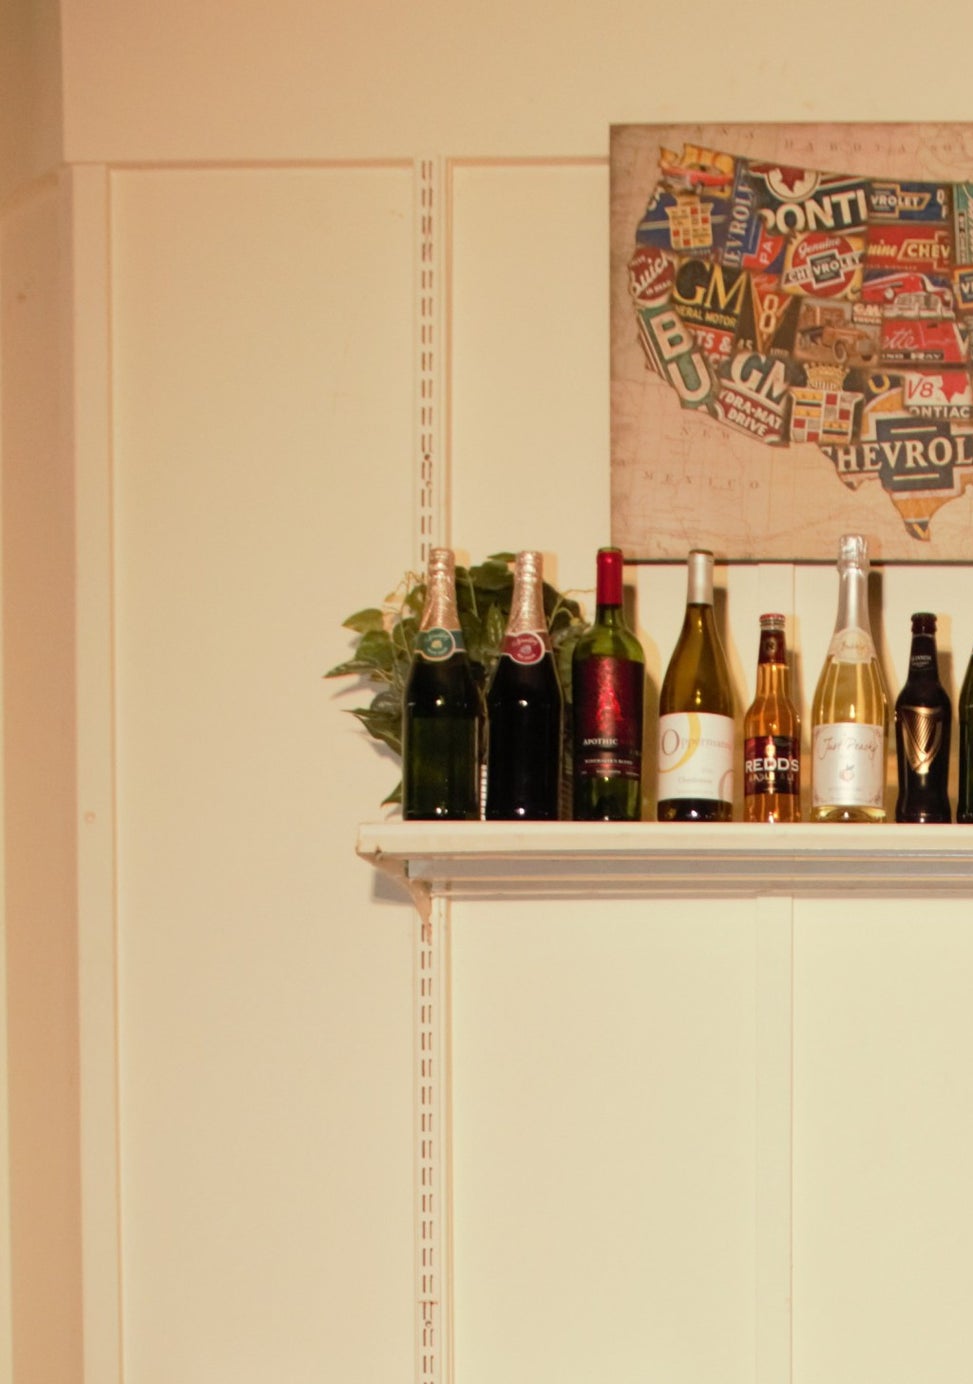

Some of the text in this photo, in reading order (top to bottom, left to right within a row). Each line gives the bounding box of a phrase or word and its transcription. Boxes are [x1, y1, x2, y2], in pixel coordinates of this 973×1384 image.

[906, 377, 934, 399] V8
[727, 408, 768, 437] DRIVE
[583, 737, 618, 748] APOTHIC
